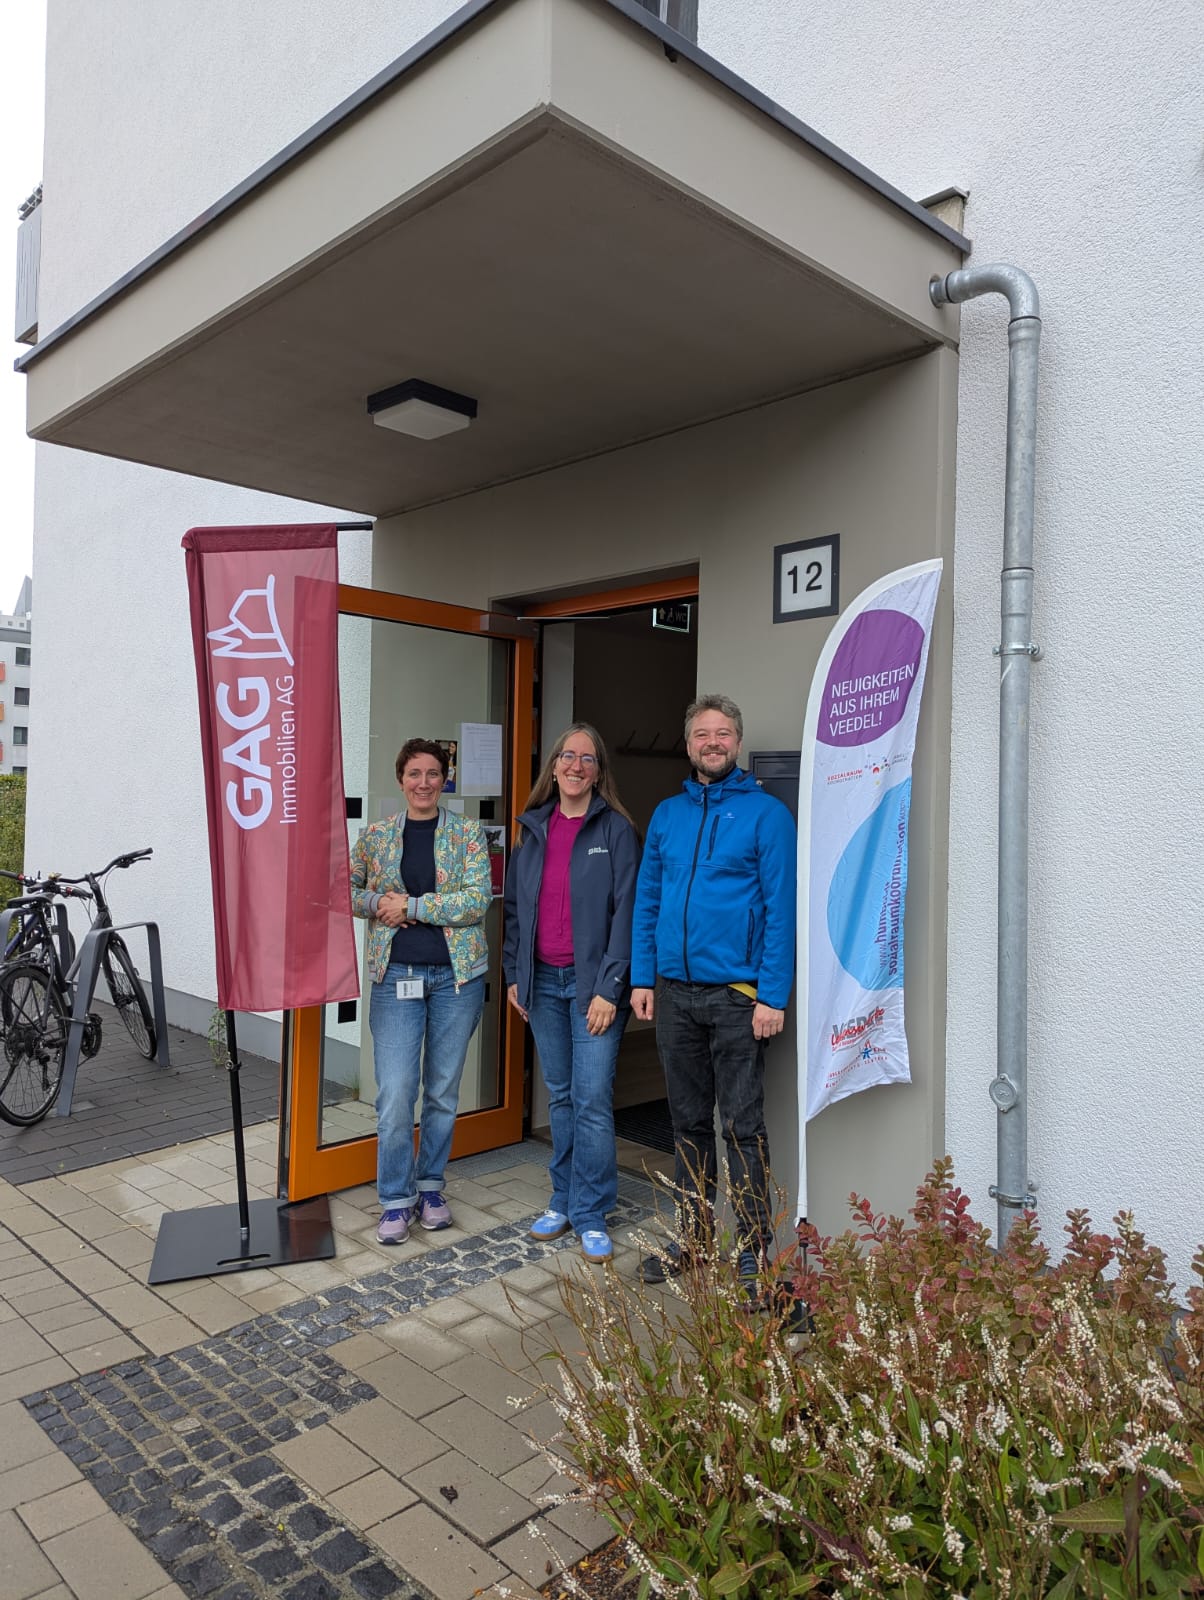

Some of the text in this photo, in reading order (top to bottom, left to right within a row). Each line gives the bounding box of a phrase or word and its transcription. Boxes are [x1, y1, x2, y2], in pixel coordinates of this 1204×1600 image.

[787, 561, 822, 594] 12
[675, 611, 688, 623] WC
[831, 662, 915, 699] NEUIGKEITEN
[829, 686, 901, 719] AUS IHREM
[829, 711, 883, 737] VEEDEL!
[216, 676, 272, 830] GAG
[276, 675, 297, 824] Immobilien AG
